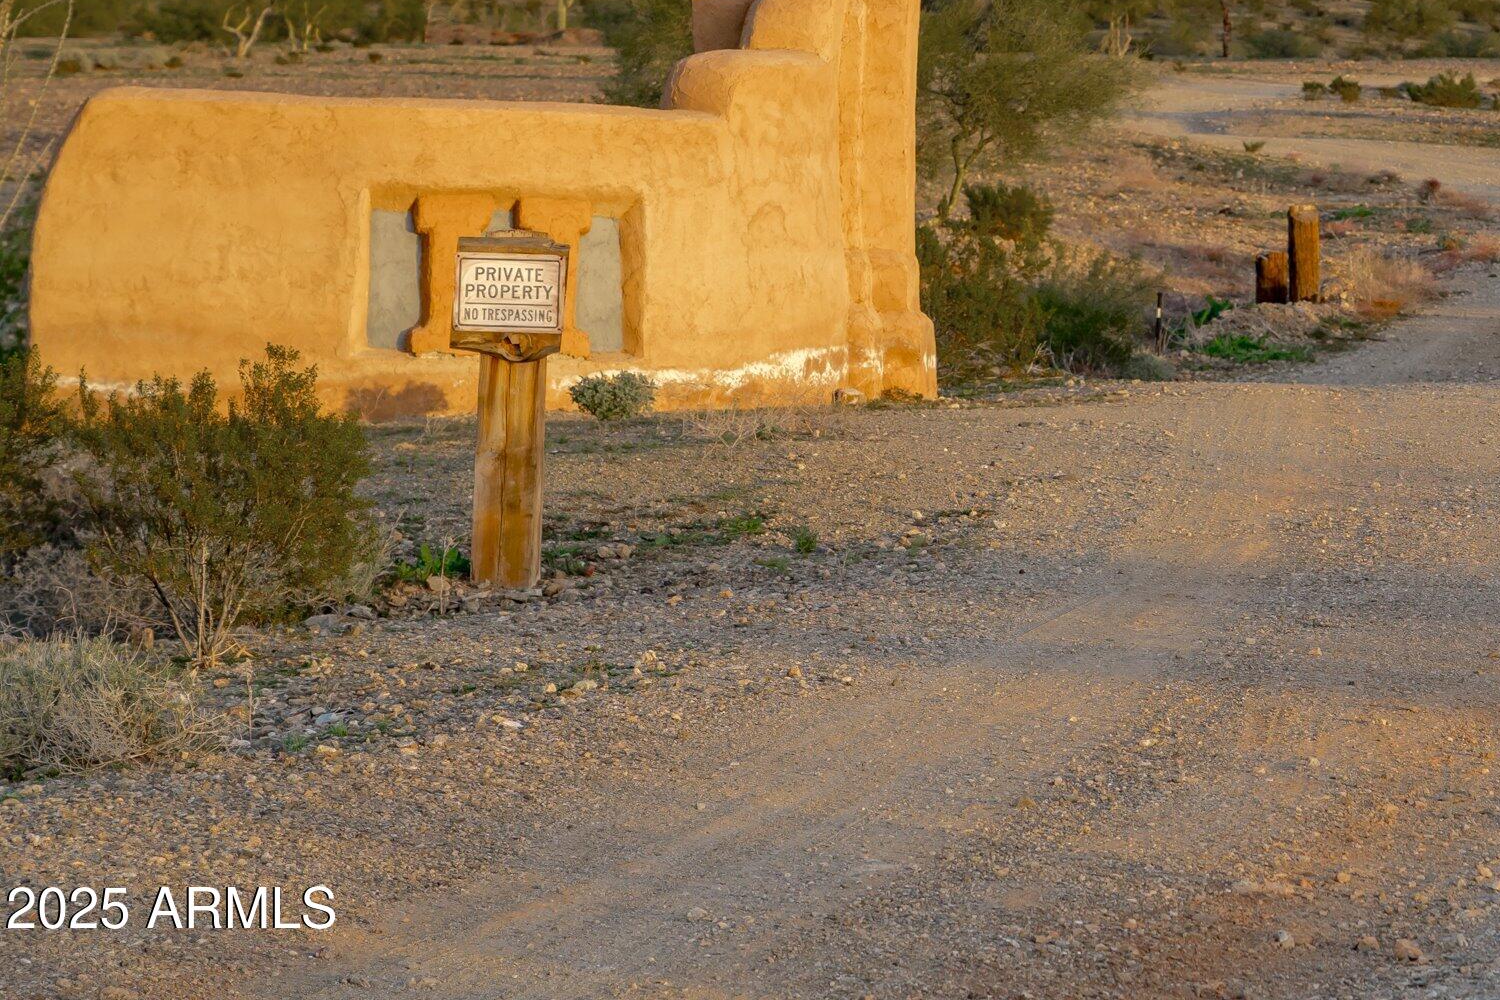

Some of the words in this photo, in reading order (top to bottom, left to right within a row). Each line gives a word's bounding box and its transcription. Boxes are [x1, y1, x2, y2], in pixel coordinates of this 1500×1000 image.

[474, 266, 544, 283] PRIVATE
[464, 283, 554, 300] PROPERTY
[463, 307, 479, 321] NO
[481, 307, 553, 323] TRESPASSING
